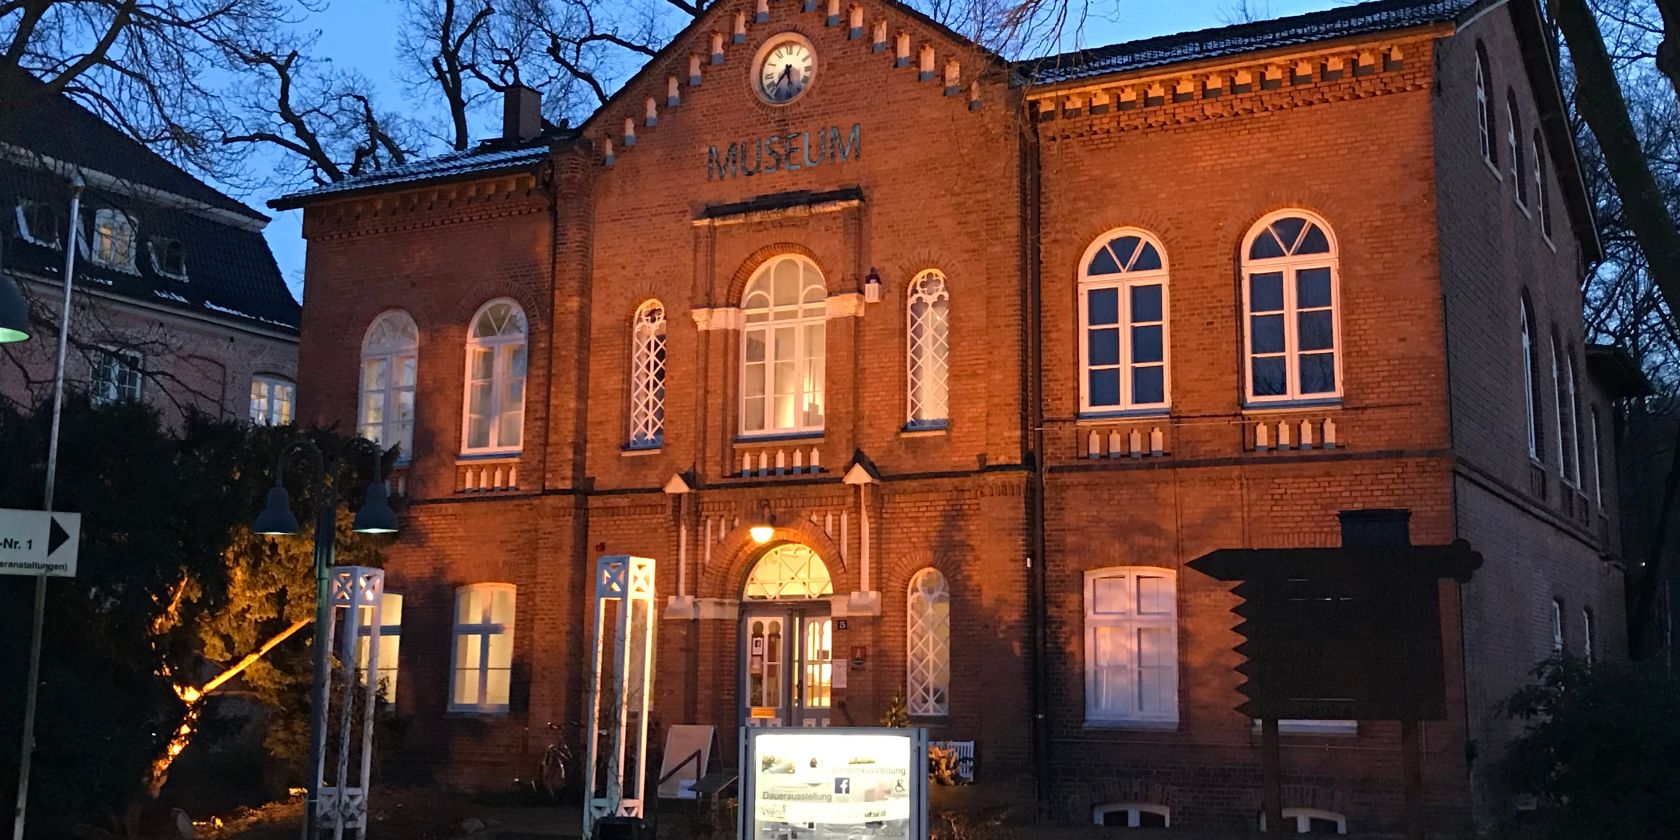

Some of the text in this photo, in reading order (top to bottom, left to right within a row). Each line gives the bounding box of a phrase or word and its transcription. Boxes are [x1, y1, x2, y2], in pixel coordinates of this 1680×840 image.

[708, 123, 861, 182] MUSEUM
[27, 539, 32, 550] 1
[762, 791, 832, 803] Dauerausstellung
